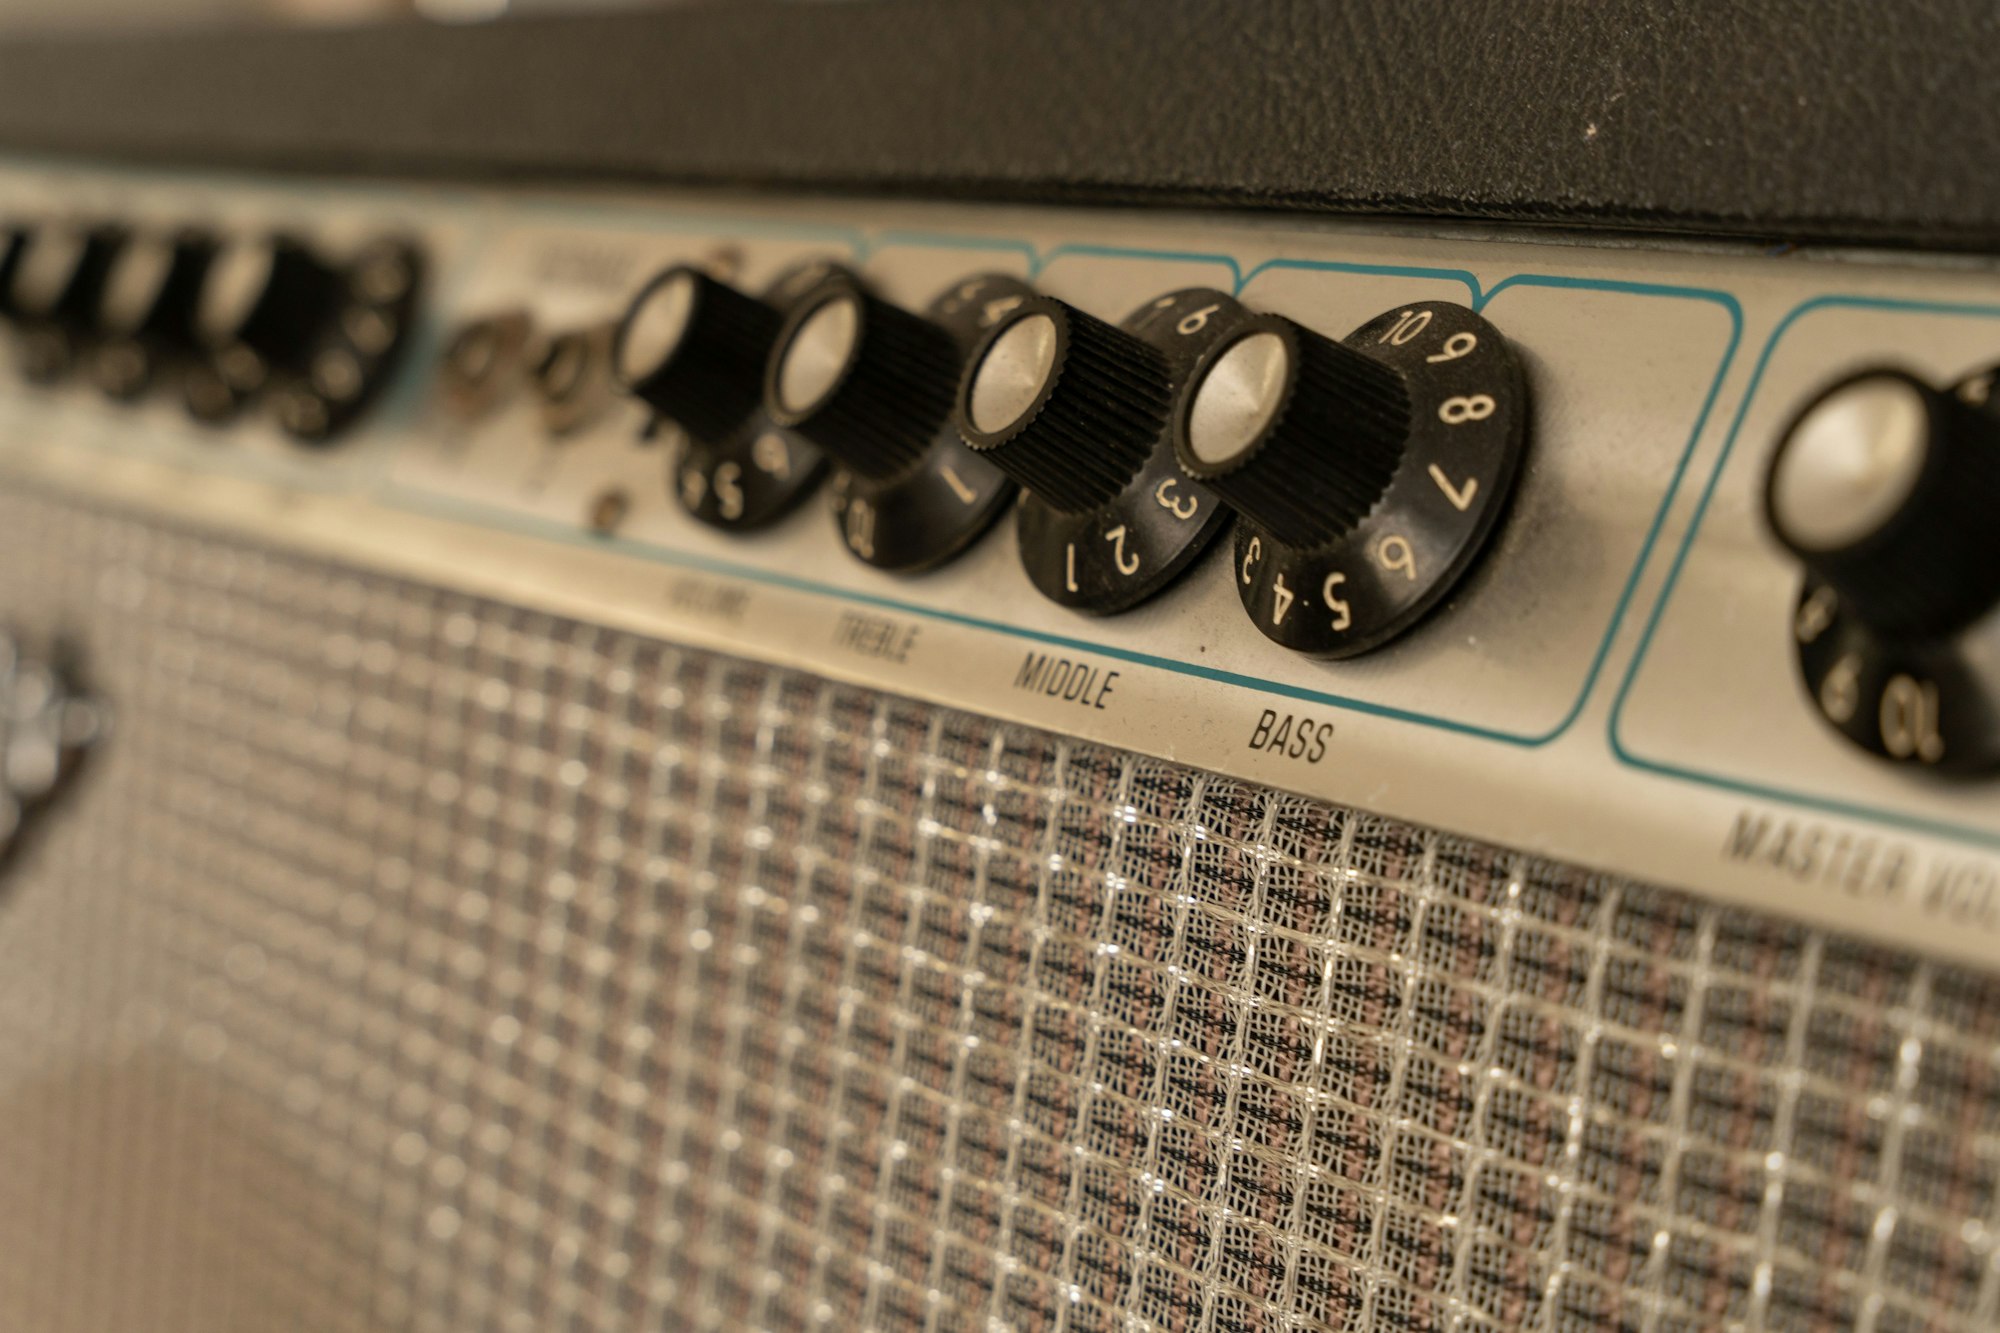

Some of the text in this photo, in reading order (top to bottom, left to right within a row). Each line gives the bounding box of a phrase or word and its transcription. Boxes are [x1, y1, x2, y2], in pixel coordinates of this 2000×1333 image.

[1176, 303, 1220, 336] 6
[1379, 310, 1433, 345] 10
[1426, 332, 1477, 364] 9
[1438, 394, 1496, 424] 8
[939, 464, 977, 506] 1
[1156, 478, 1199, 520] 3
[1428, 463, 1479, 511] 7
[1066, 543, 1079, 593] 1
[1105, 525, 1140, 576] 2
[1243, 536, 1262, 586] 3
[1378, 535, 1417, 581] 6
[1273, 573, 1295, 626] 4
[1323, 572, 1352, 631] 5
[832, 609, 923, 666] TREBLE
[1014, 651, 1120, 709] MIDDLE
[1249, 709, 1334, 764] BASS
[1721, 808, 1914, 904] MASTER
